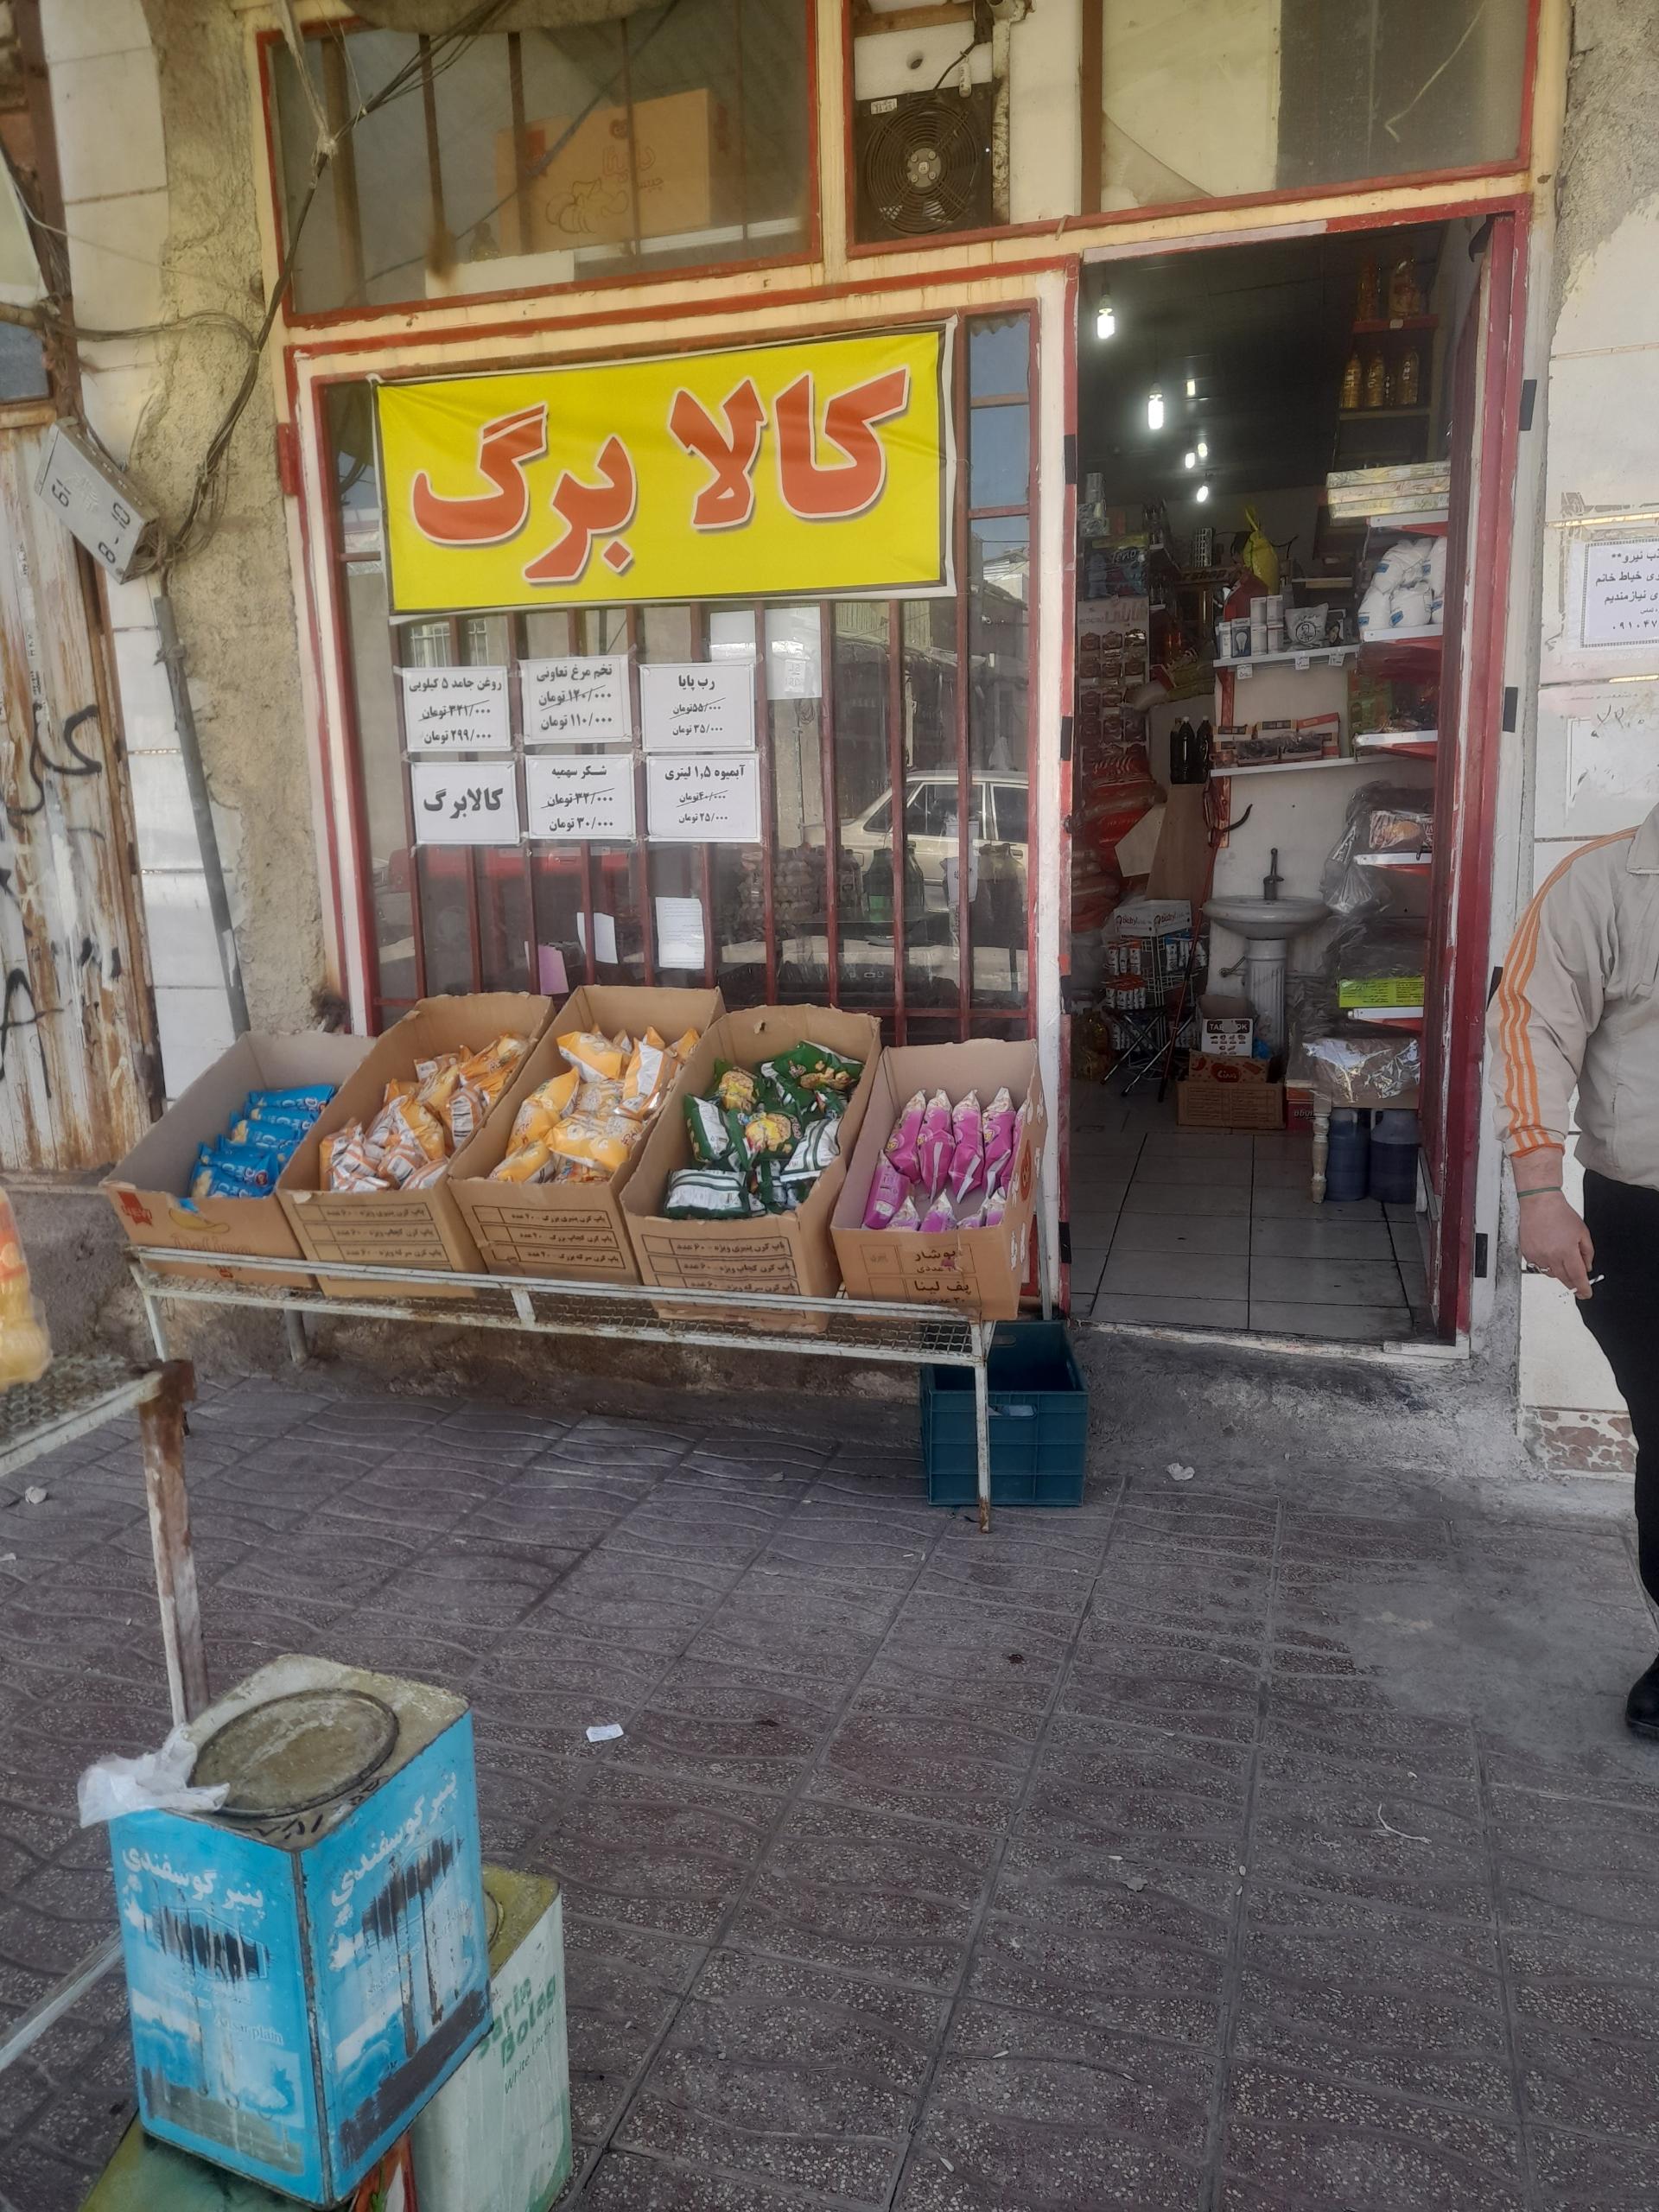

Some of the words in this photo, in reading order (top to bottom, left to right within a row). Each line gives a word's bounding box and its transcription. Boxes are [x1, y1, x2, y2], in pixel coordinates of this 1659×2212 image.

[666, 364, 911, 532] کالا
[411, 401, 638, 587] برگ
[1595, 574, 1616, 586] خانم
[1619, 571, 1642, 582] خیاط
[1605, 590, 1647, 605] نیازمندیم
[537, 666, 568, 682] تعاونی
[570, 664, 591, 681] مرغ
[594, 664, 613, 679] تخم
[409, 677, 439, 692] کیلویی
[442, 677, 448, 689] ۵
[452, 677, 474, 690] جامد
[477, 677, 501, 691] روغن
[678, 675, 695, 691] پایا
[697, 677, 715, 690] رب
[538, 690, 566, 706] تومان
[422, 706, 448, 720] تومان
[570, 712, 613, 727] ۱۱۰/۰۰۰
[540, 715, 568, 730] تومان
[693, 724, 723, 734] ۳۵/۰۰۰
[450, 728, 492, 741] ۲۹۹/۰۰۰
[672, 725, 692, 735] تومان
[423, 731, 448, 744] تومان
[551, 768, 578, 779] سهمیه
[581, 765, 607, 779] شکر
[664, 766, 691, 780] لیتری
[714, 764, 746, 780] آبمیوه
[423, 787, 504, 819] کالابرگ
[547, 793, 573, 807] تومان
[549, 817, 575, 831] تومان
[576, 817, 613, 830] ۳۰/۰۰۰
[678, 813, 698, 823] تومان
[699, 812, 728, 823] ۲۵/۰۰۰
[914, 1281, 940, 1295] لینا
[946, 1280, 972, 1295] پف
[331, 1795, 425, 1907] گوسفندی
[122, 1847, 217, 1901] گوسفندی
[222, 1882, 265, 1919] پنیر
